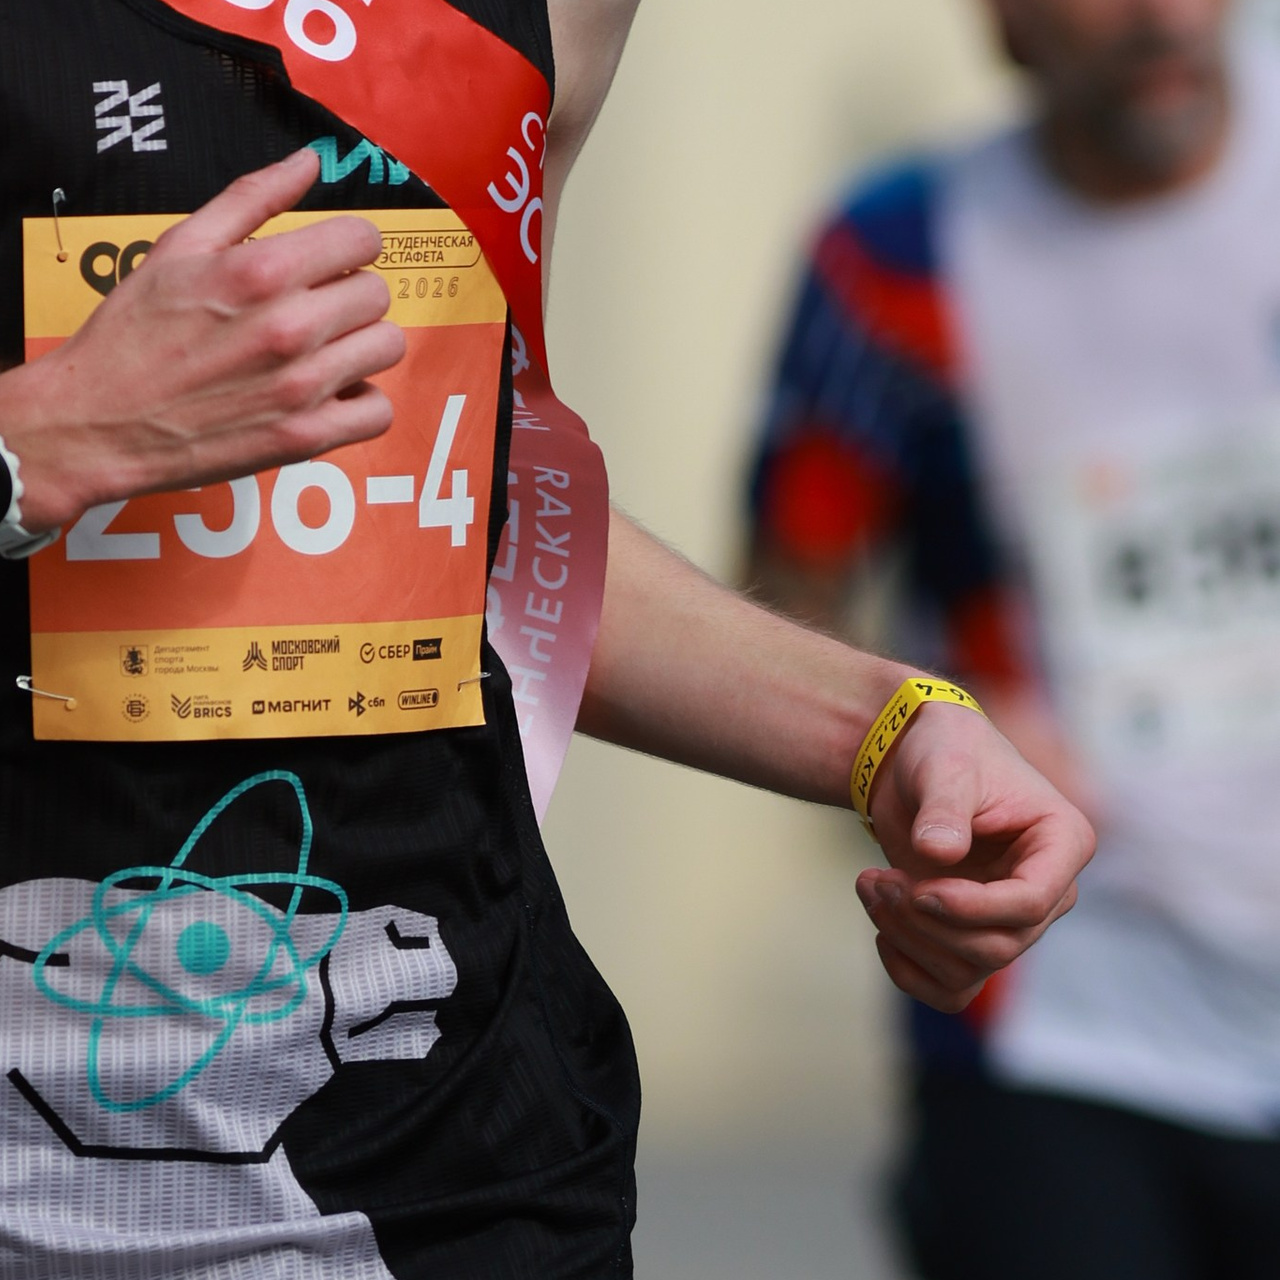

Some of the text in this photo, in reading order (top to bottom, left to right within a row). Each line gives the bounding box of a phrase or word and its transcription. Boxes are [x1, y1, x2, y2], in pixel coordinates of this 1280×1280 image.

[381, 235, 474, 250] СТУДЕНЧЕСКАЯ
[380, 250, 444, 264] ЭСТАФЕТА
[397, 276, 460, 299] 2026
[272, 635, 340, 655] МОСКОВСКИЙ
[378, 644, 411, 659] СБЕР
[272, 656, 304, 671] СПОРТ
[401, 693, 431, 706] WINLINE
[193, 706, 232, 718] BRICS
